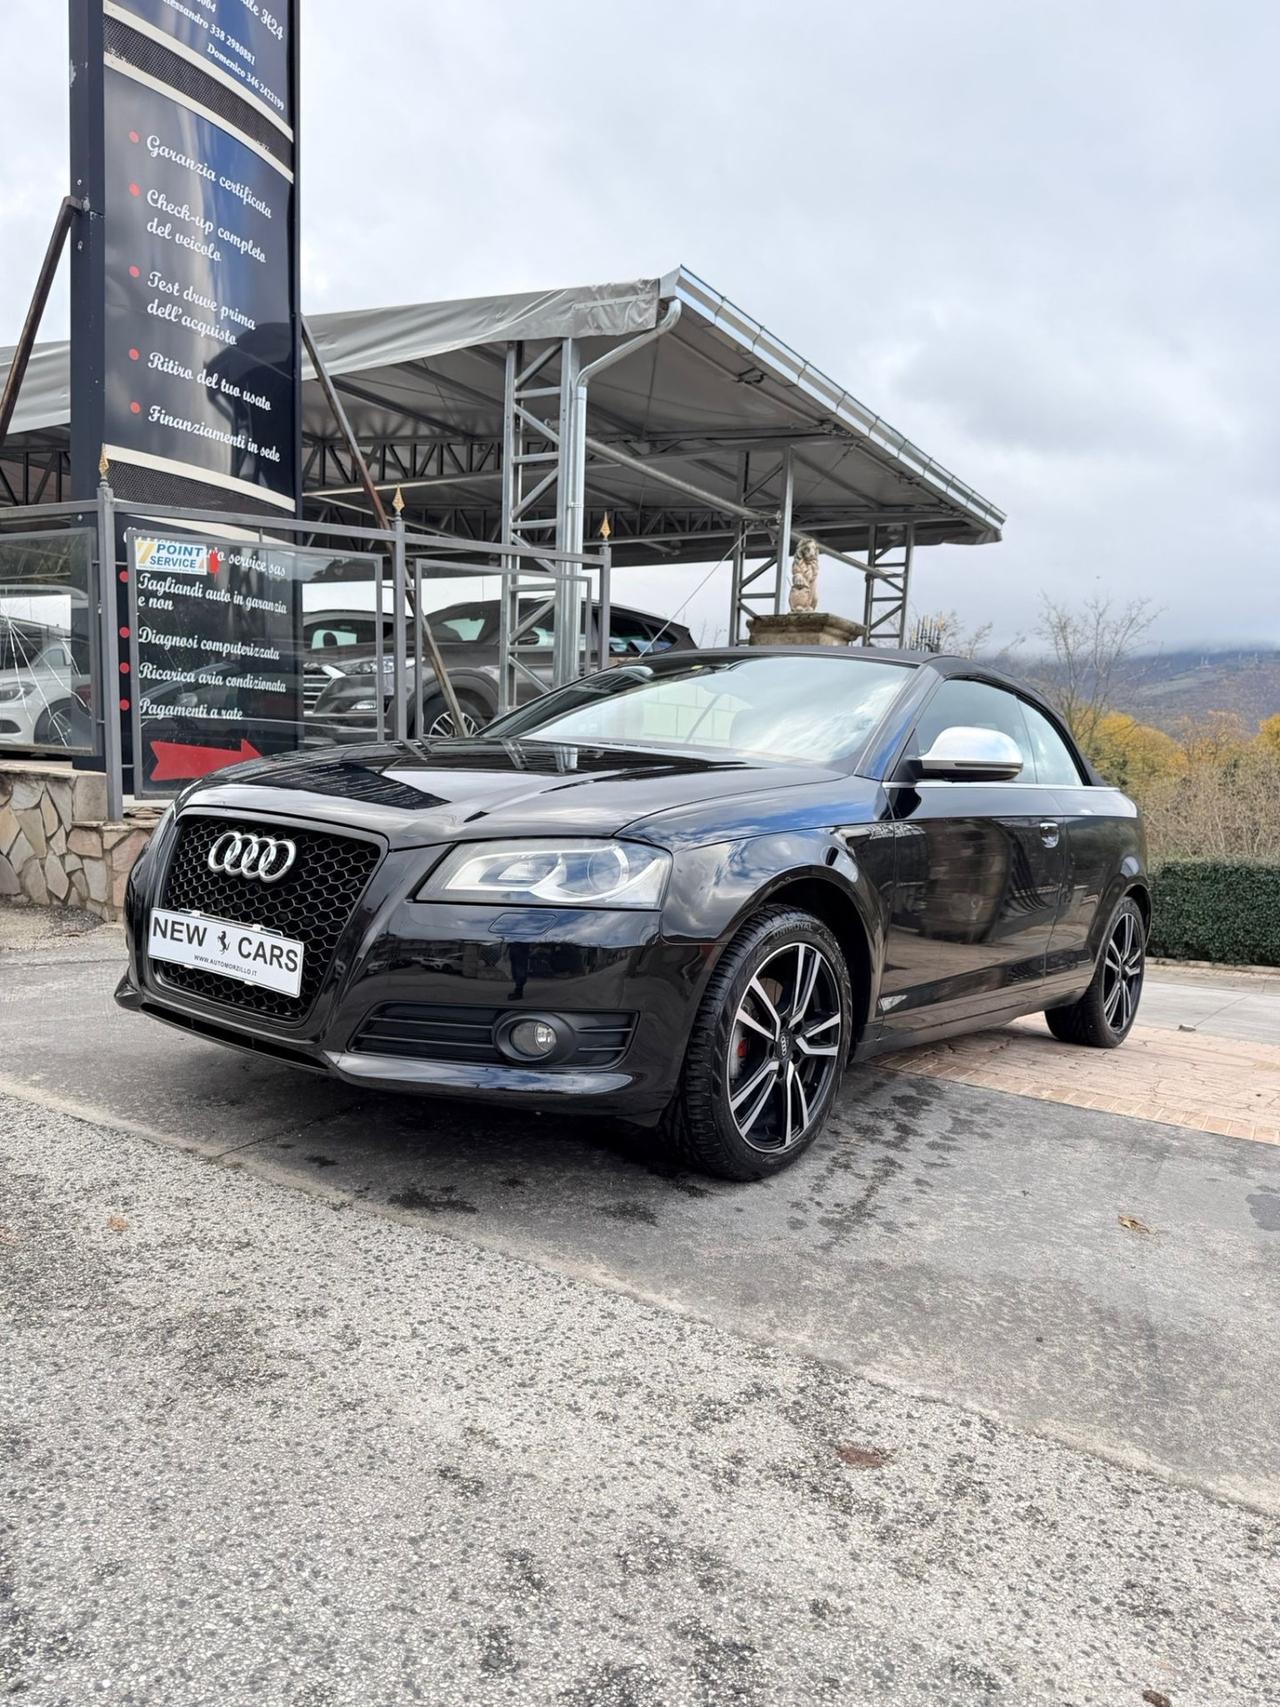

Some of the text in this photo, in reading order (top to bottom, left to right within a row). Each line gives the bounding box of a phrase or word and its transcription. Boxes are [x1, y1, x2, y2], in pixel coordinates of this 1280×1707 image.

[207, 41, 245, 78] Domenico
[147, 135, 272, 219] Garanzia certificata
[147, 189, 266, 263] Check-up completo
[147, 218, 222, 262] del veicolo
[147, 271, 257, 330] Test drive prima
[148, 352, 272, 412] Ritiro del tuo usato
[148, 405, 281, 463] Finanziamenti in sede
[150, 556, 196, 569] SERVICE
[156, 544, 203, 558] POINT
[229, 553, 267, 573] service
[269, 564, 285, 577] sas
[138, 573, 287, 614] Tagliandi auto in garanzia
[138, 595, 175, 611] e non
[138, 626, 280, 661] Diagnosi computerizzata
[138, 662, 287, 693] Ricarica aria condizionata
[139, 698, 243, 721] Pagamenti a rate
[152, 916, 299, 974] NEW CARS
